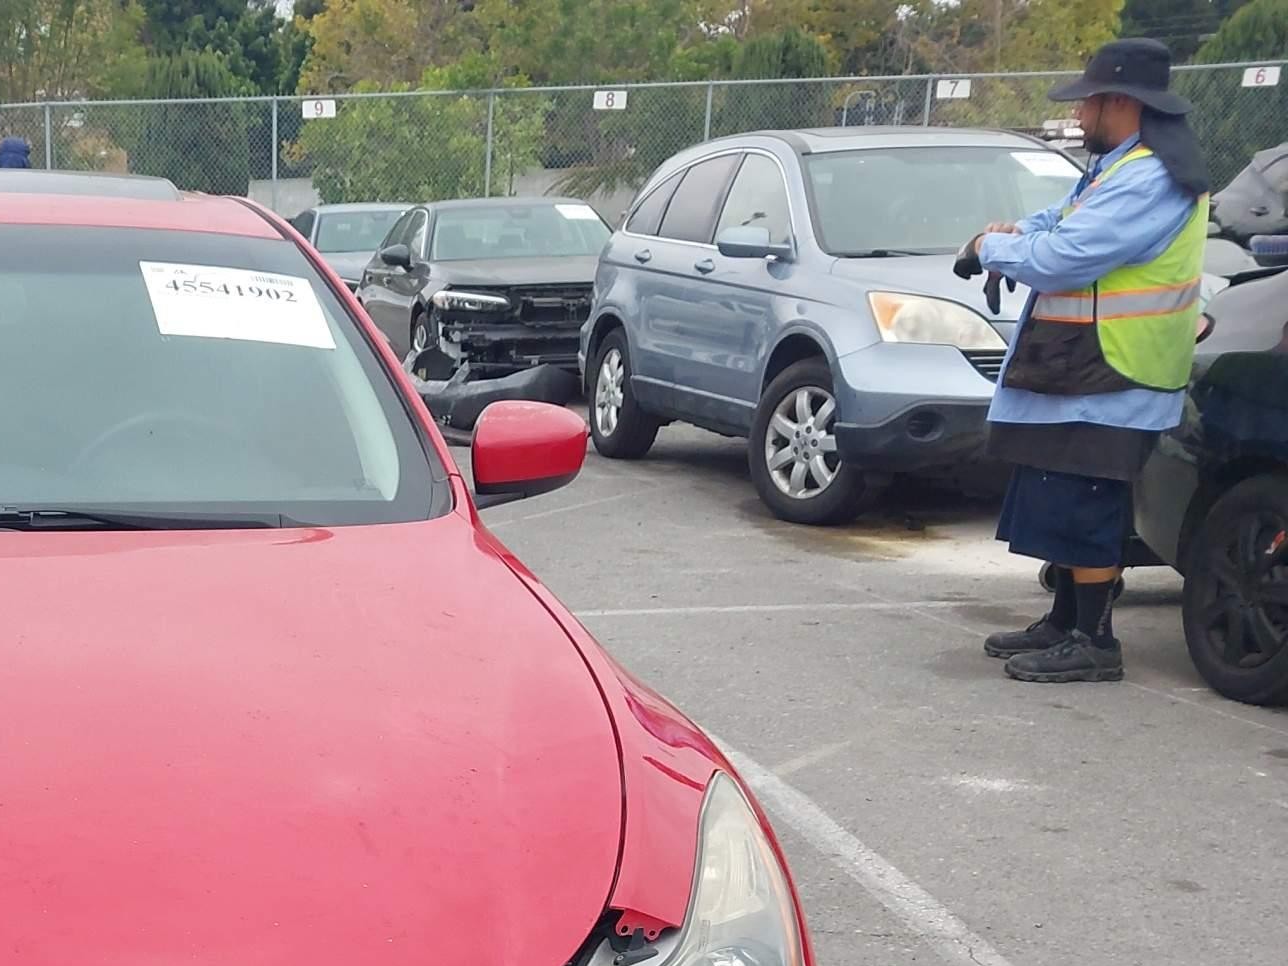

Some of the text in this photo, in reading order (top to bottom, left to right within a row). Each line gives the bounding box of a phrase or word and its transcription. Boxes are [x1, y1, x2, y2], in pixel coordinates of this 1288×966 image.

[1255, 68, 1266, 85] 6
[949, 80, 960, 97] 7
[605, 92, 615, 108] 8
[314, 101, 324, 117] 9
[165, 278, 298, 303] 45541902
